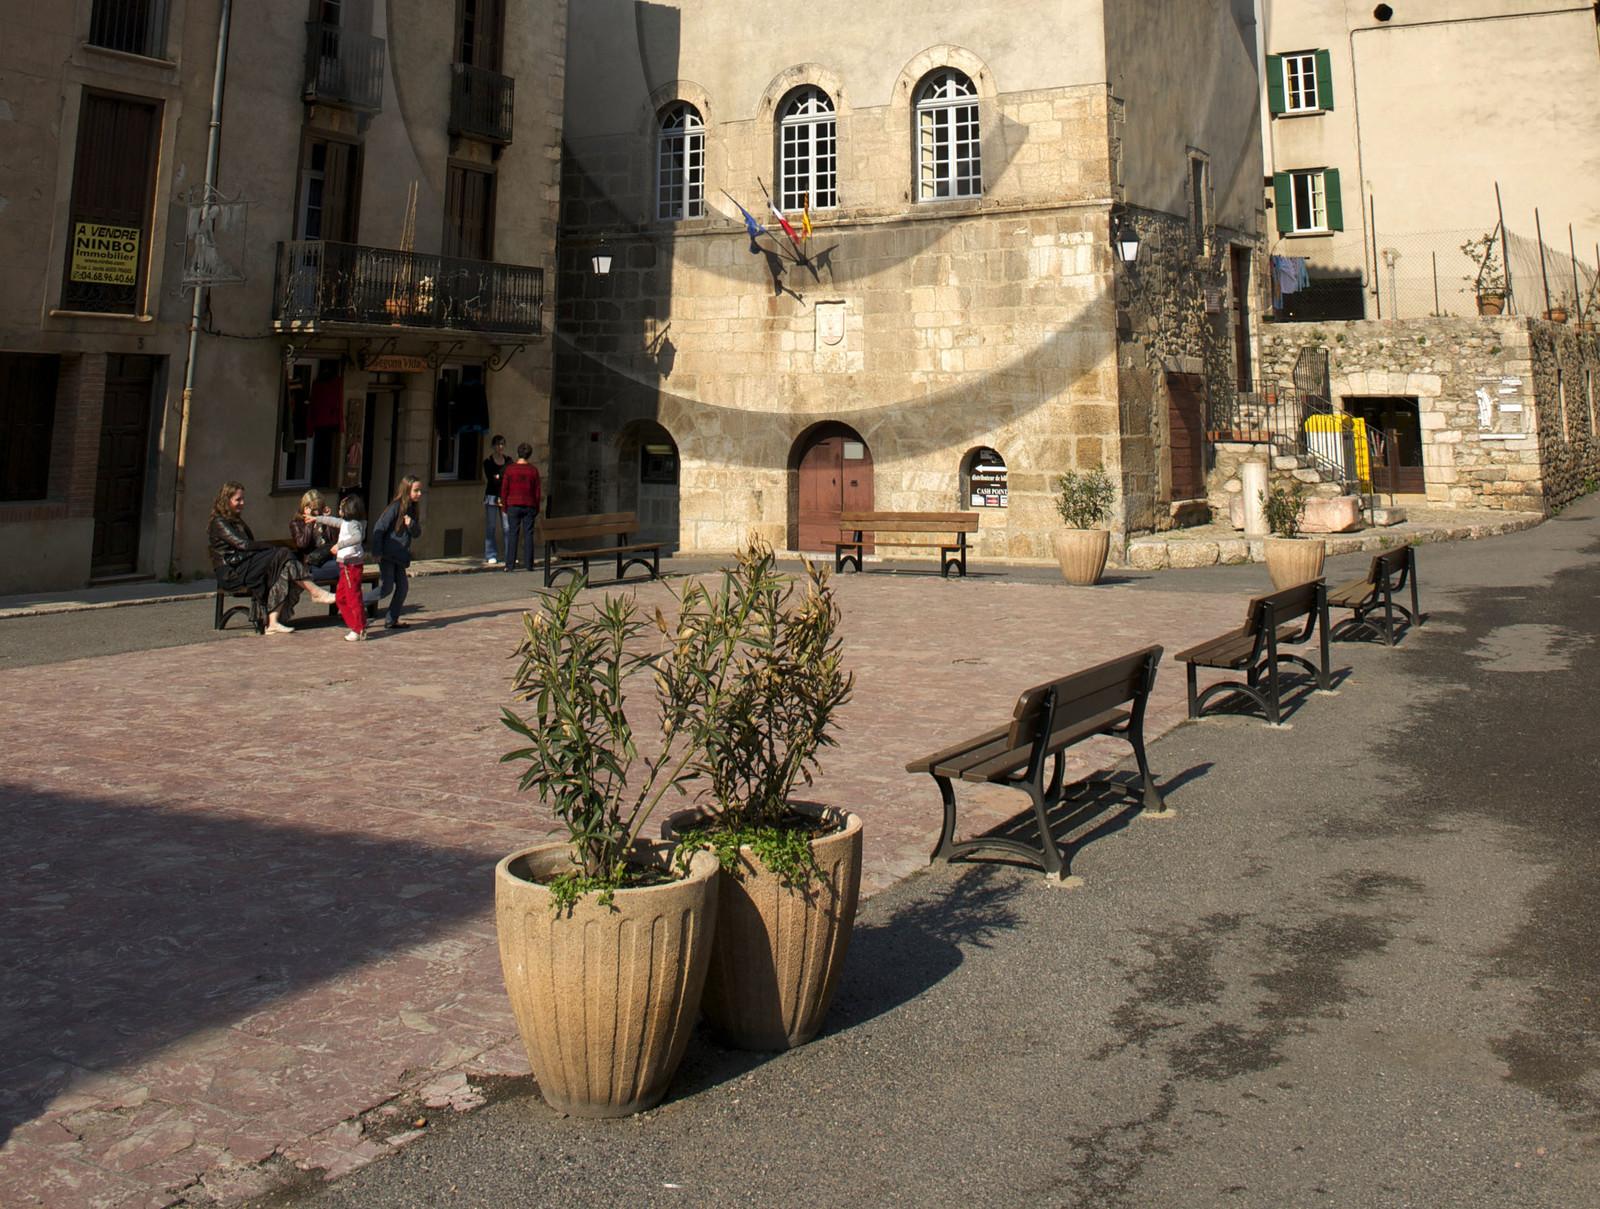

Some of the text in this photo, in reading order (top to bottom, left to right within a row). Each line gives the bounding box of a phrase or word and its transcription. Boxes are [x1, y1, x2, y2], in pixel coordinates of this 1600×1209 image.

[77, 225, 138, 240] A VENDRE
[77, 237, 135, 253] NINBO
[76, 249, 135, 261] Immobilier
[137, 337, 144, 350] 3
